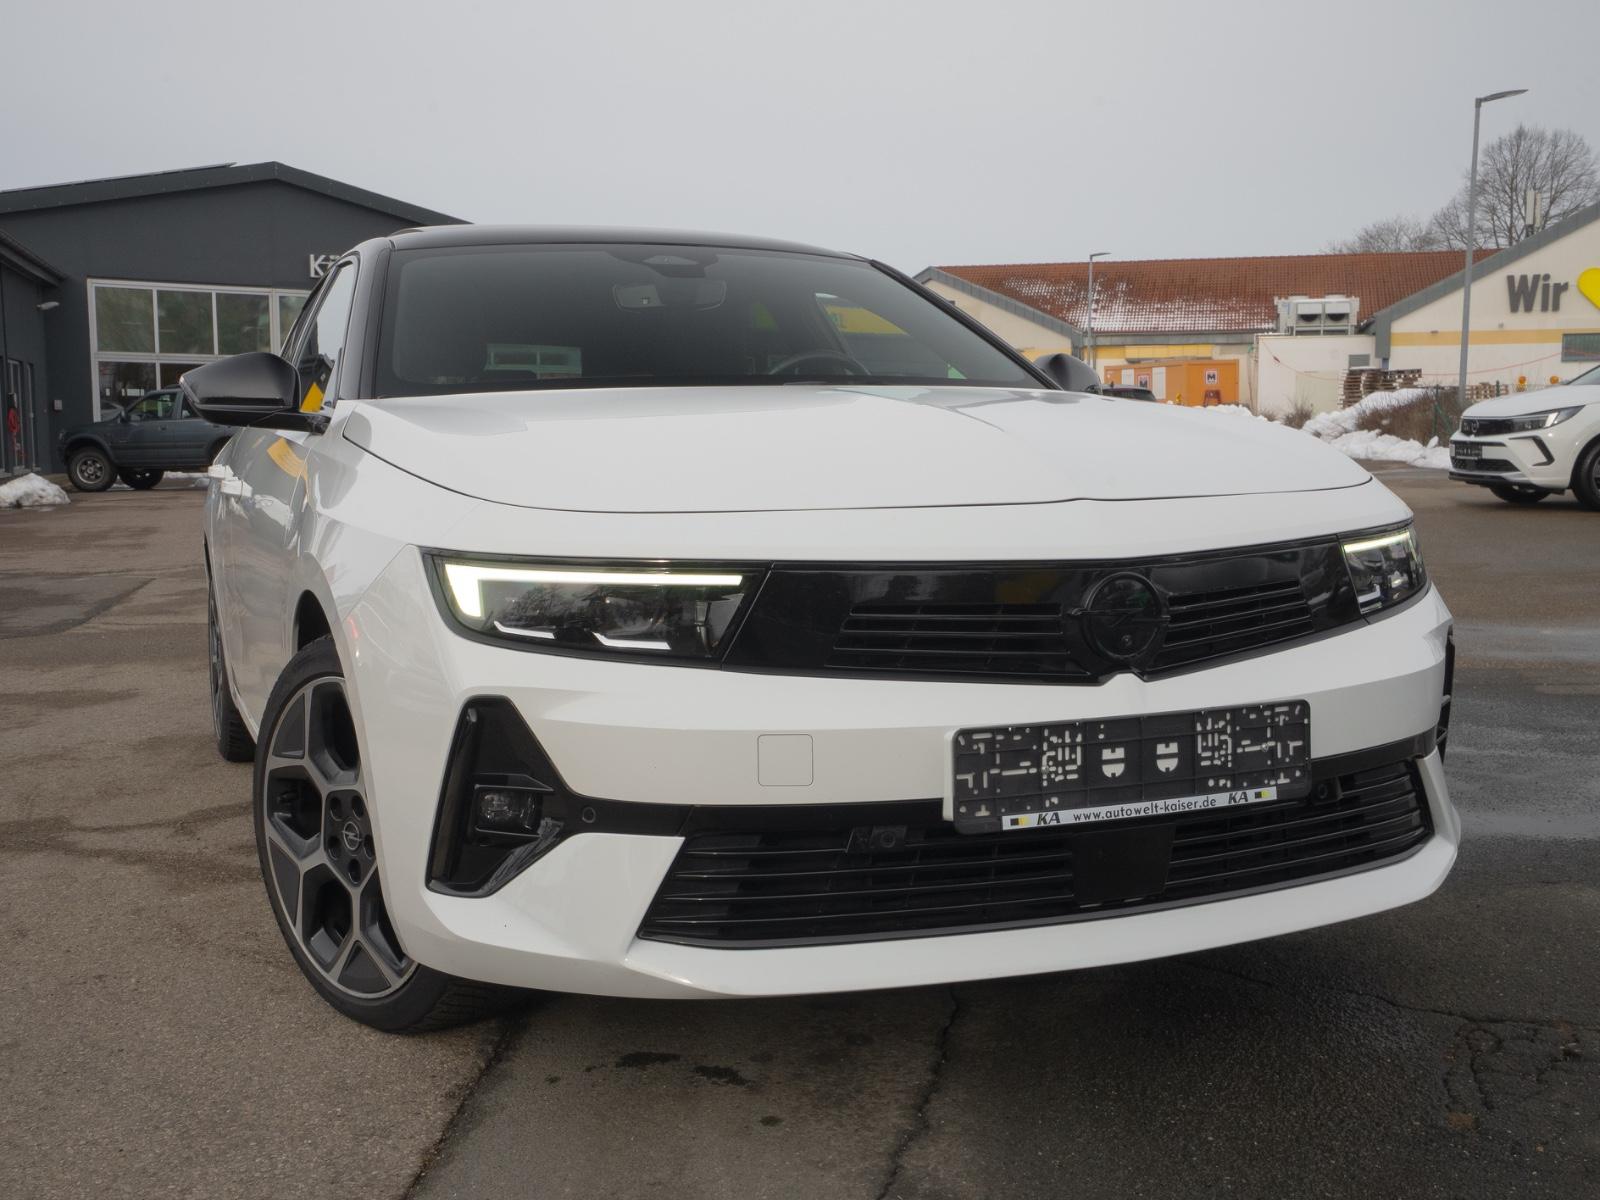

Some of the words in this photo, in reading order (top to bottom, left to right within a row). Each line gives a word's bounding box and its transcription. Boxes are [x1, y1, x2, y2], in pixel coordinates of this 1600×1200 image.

[1507, 273, 1569, 313] Wir
[1207, 373, 1216, 381] M
[1037, 812, 1061, 825] KA
[1073, 796, 1217, 822] www.autowelt-kaiser.de
[1228, 791, 1249, 805] KA
